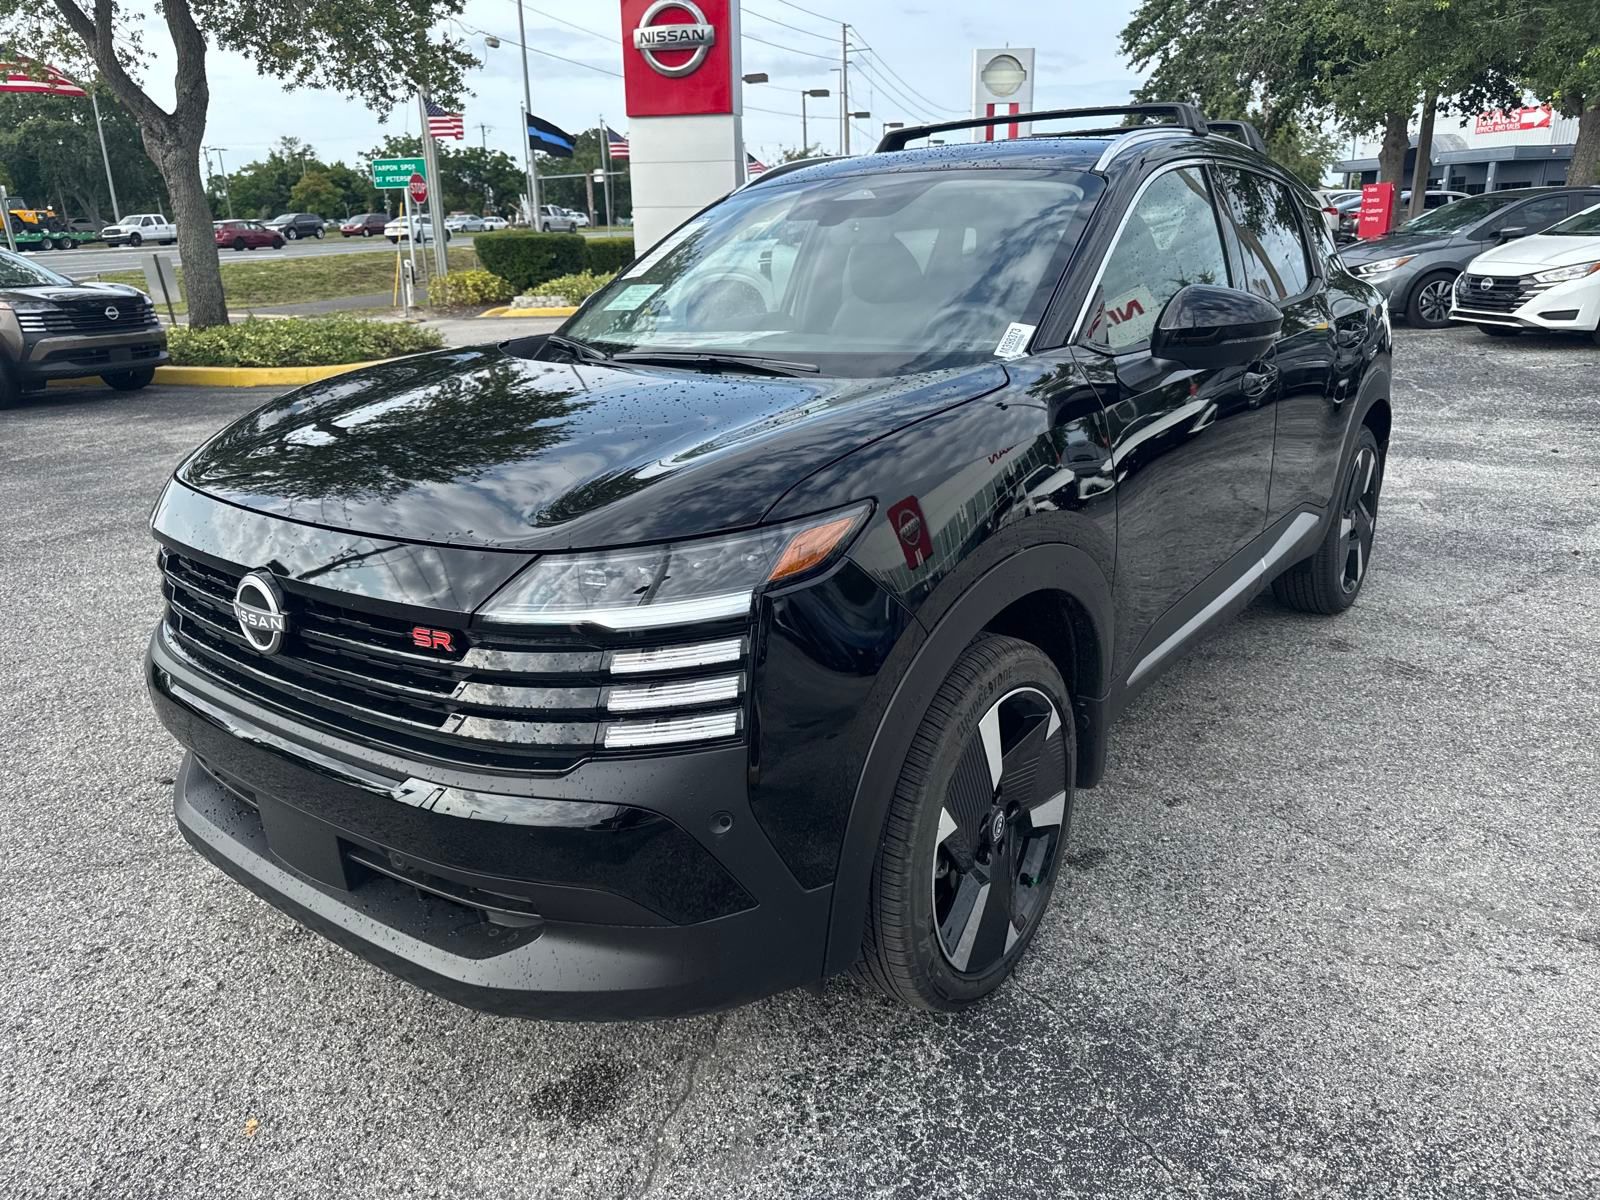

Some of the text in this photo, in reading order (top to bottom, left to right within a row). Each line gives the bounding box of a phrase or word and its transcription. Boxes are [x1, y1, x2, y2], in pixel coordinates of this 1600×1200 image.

[640, 29, 704, 44] NISSAN
[1495, 124, 1506, 132] AND
[410, 182, 426, 194] STOP
[412, 627, 453, 652] SR
